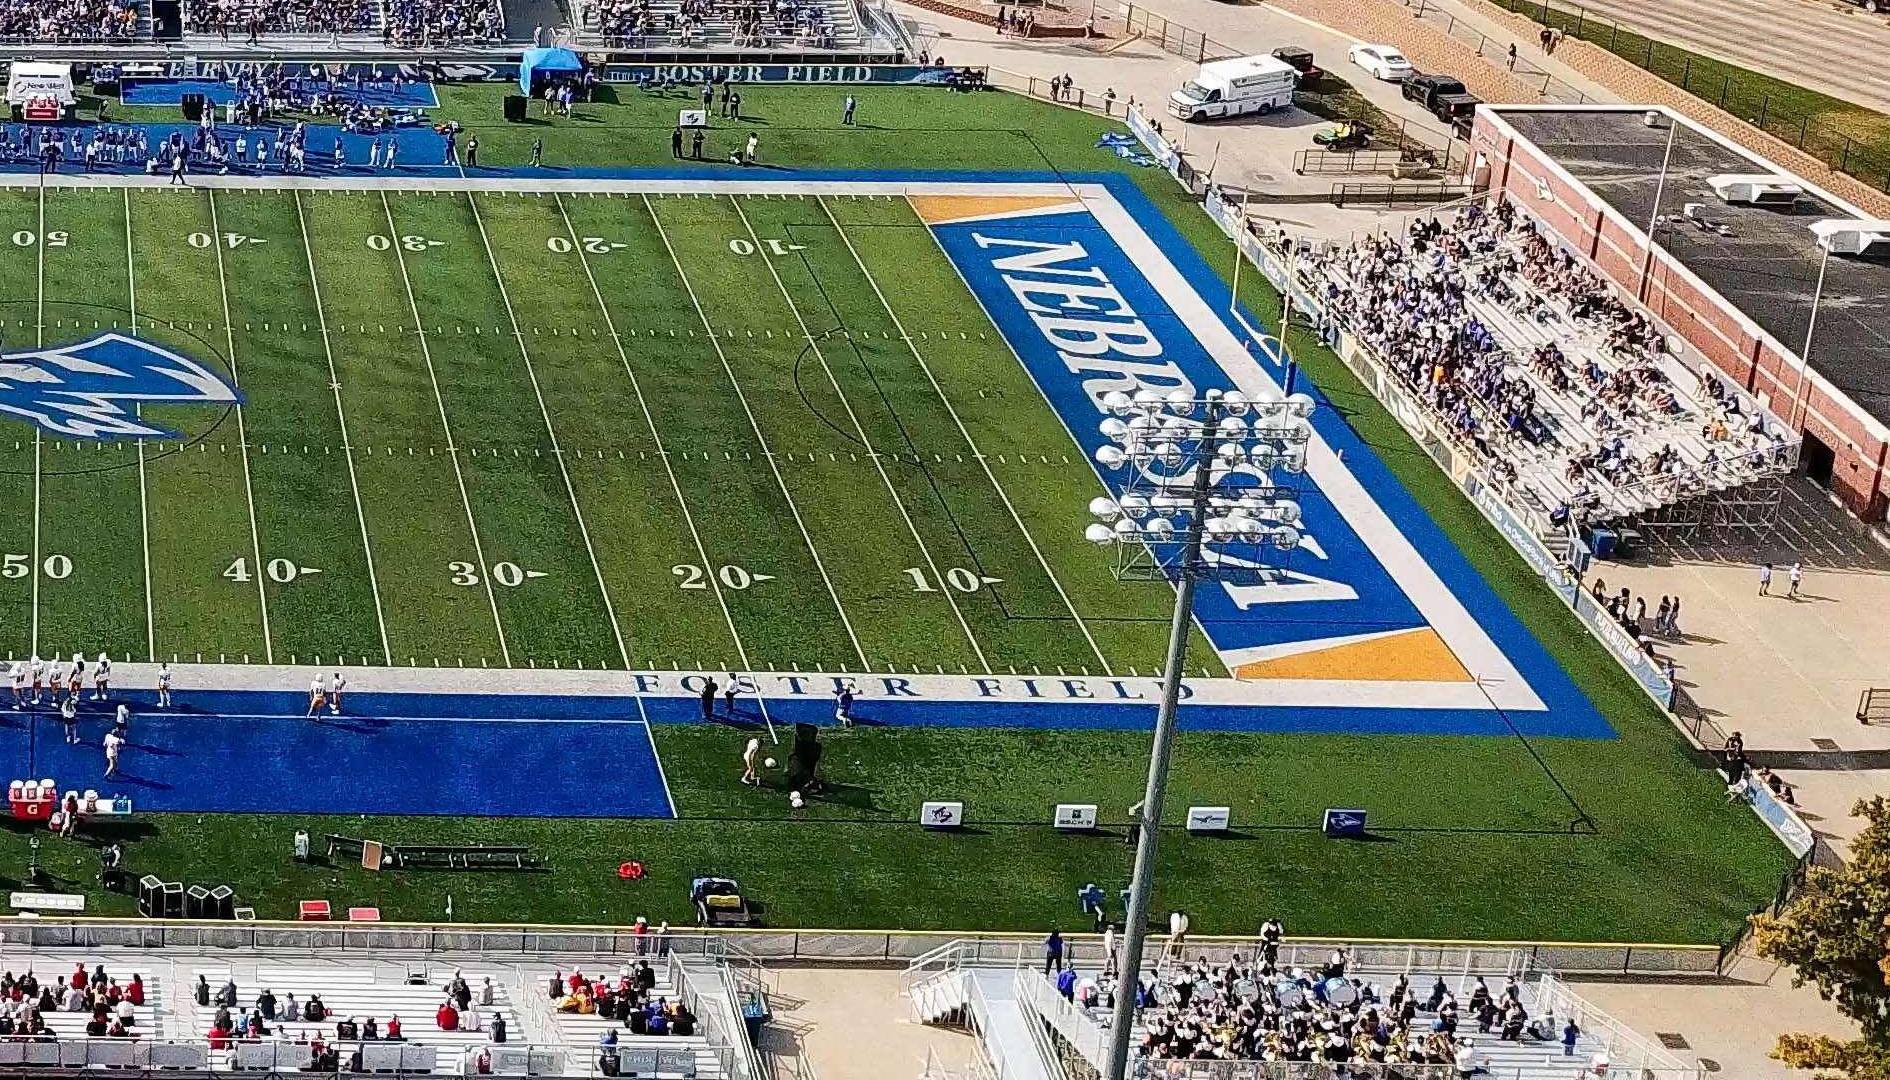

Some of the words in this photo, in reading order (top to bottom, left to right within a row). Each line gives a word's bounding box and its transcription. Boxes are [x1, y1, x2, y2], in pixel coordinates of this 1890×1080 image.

[654, 66, 763, 82] FOSTER
[787, 66, 873, 82] FIELD
[13, 230, 70, 247] 50
[188, 231, 249, 248] 40
[367, 233, 429, 251] 30
[548, 235, 612, 253] 20
[730, 237, 792, 256] 10
[971, 232, 1359, 612] NEBRSA
[2, 553, 73, 579] 50
[222, 557, 297, 583] 40
[448, 560, 524, 587] 30
[671, 563, 752, 591] 20
[902, 566, 980, 594] 10
[631, 674, 921, 698] FOSTER
[27, 805, 38, 815] G
